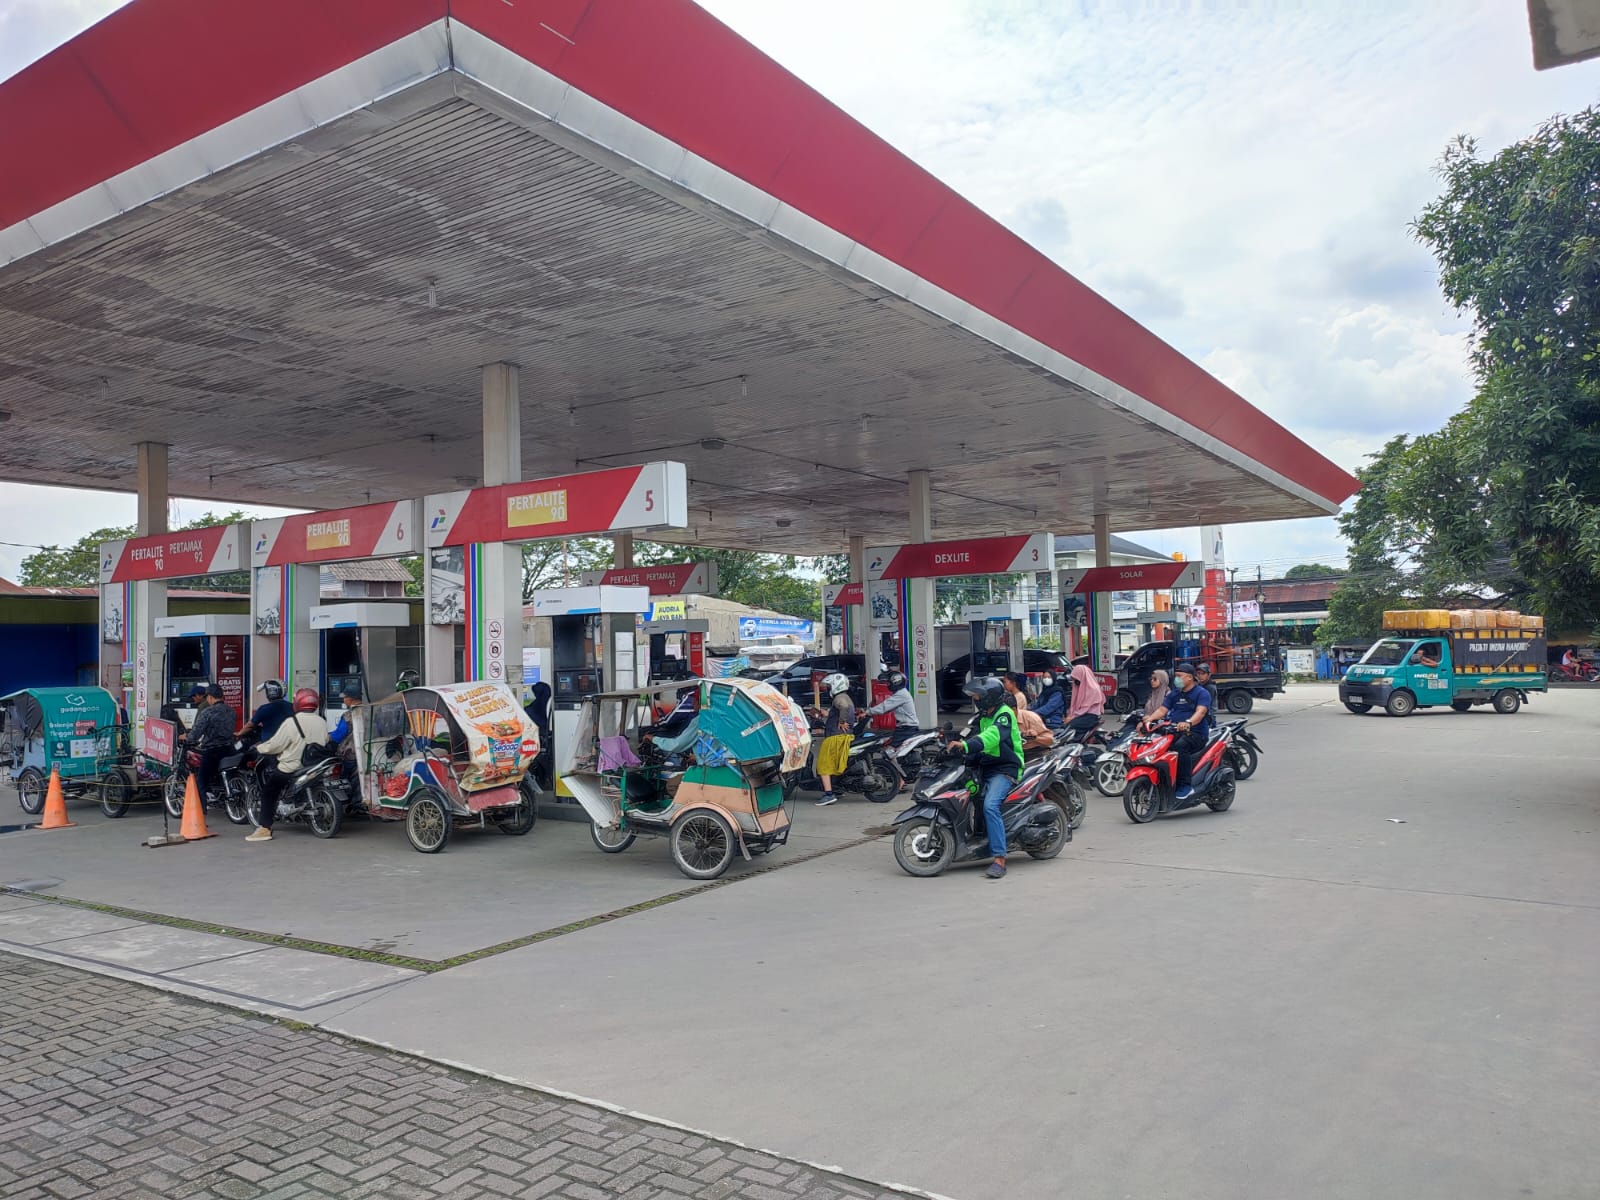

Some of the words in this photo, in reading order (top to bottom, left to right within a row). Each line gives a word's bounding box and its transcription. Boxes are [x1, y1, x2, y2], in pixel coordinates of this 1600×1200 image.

[508, 491, 566, 512] PERTALITE
[645, 490, 654, 511] 5
[550, 505, 566, 521] 90
[307, 520, 349, 537] PERTALITE
[396, 522, 404, 541] 6
[338, 532, 349, 545] 90
[131, 545, 164, 561] PERTALITE
[169, 540, 203, 554] PERTAMAX
[226, 543, 233, 560] 7
[934, 552, 970, 564] DEXLITE
[1032, 549, 1039, 561] 3
[154, 559, 164, 571] 90
[194, 552, 203, 563] 92
[610, 574, 640, 584] PERTALITE
[647, 572, 676, 581] PERTAMAX
[1120, 571, 1143, 579] SOLAR
[669, 579, 676, 588] 92
[659, 605, 680, 613] AUDRIA
